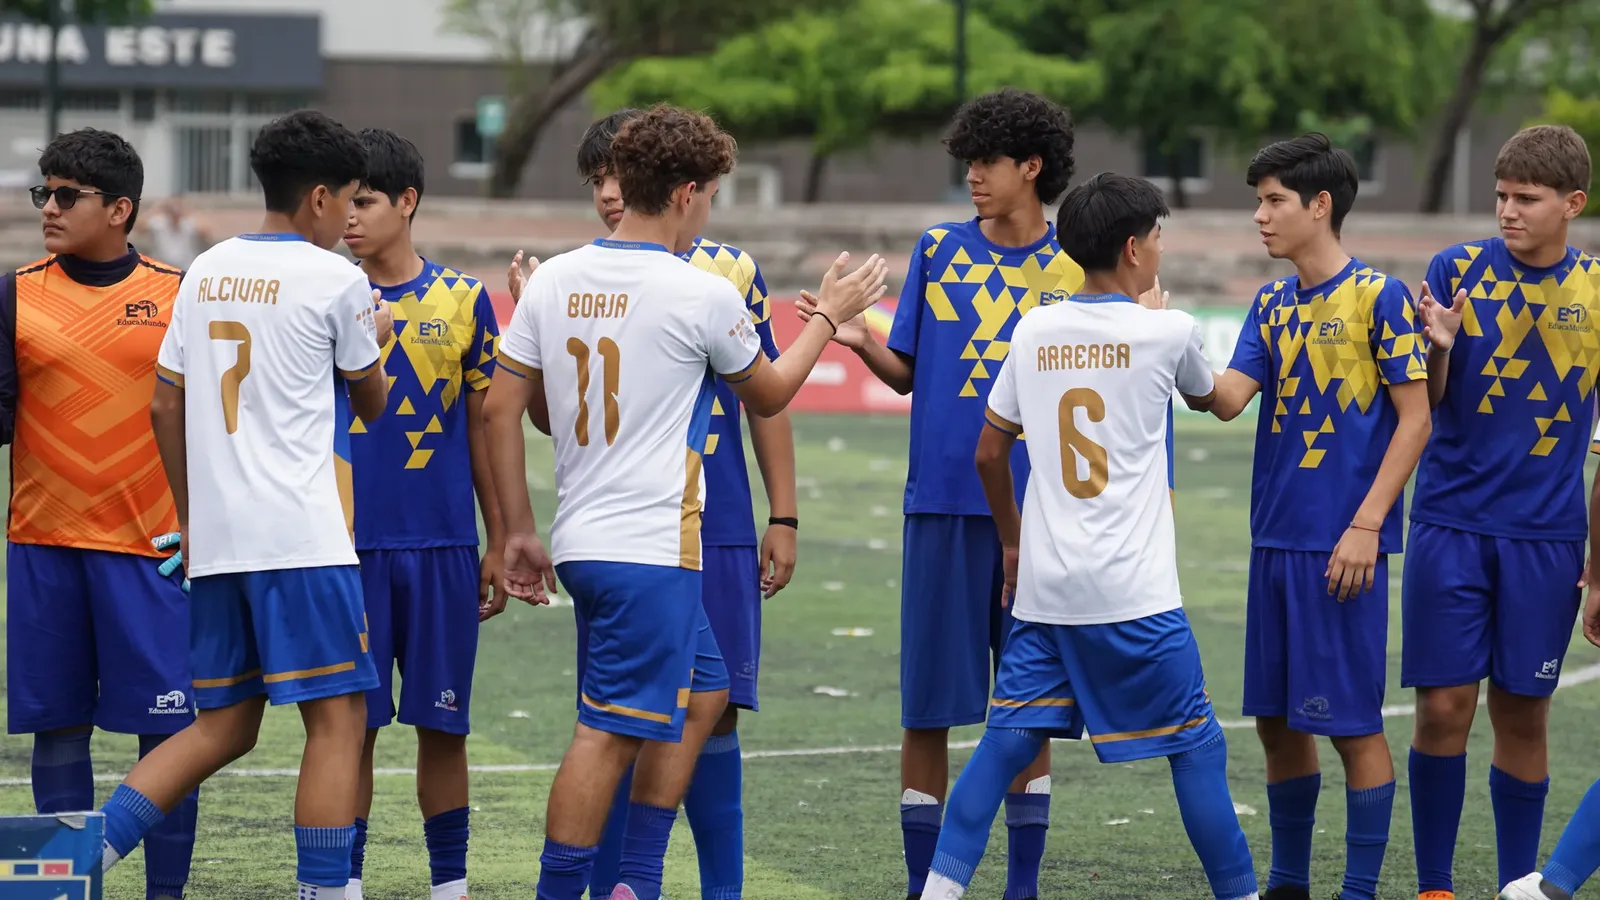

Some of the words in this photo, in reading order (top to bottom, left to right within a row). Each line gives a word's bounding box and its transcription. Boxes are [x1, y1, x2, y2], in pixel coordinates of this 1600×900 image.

[105, 26, 236, 67] ESTE
[197, 276, 280, 305] ALCIVAR
[567, 292, 629, 319] BORJA
[116, 319, 167, 328] EducaMundo
[1037, 343, 1131, 372] ARREAGA
[208, 320, 252, 435] 7
[566, 336, 621, 447] 11
[1057, 387, 1109, 499] 6
